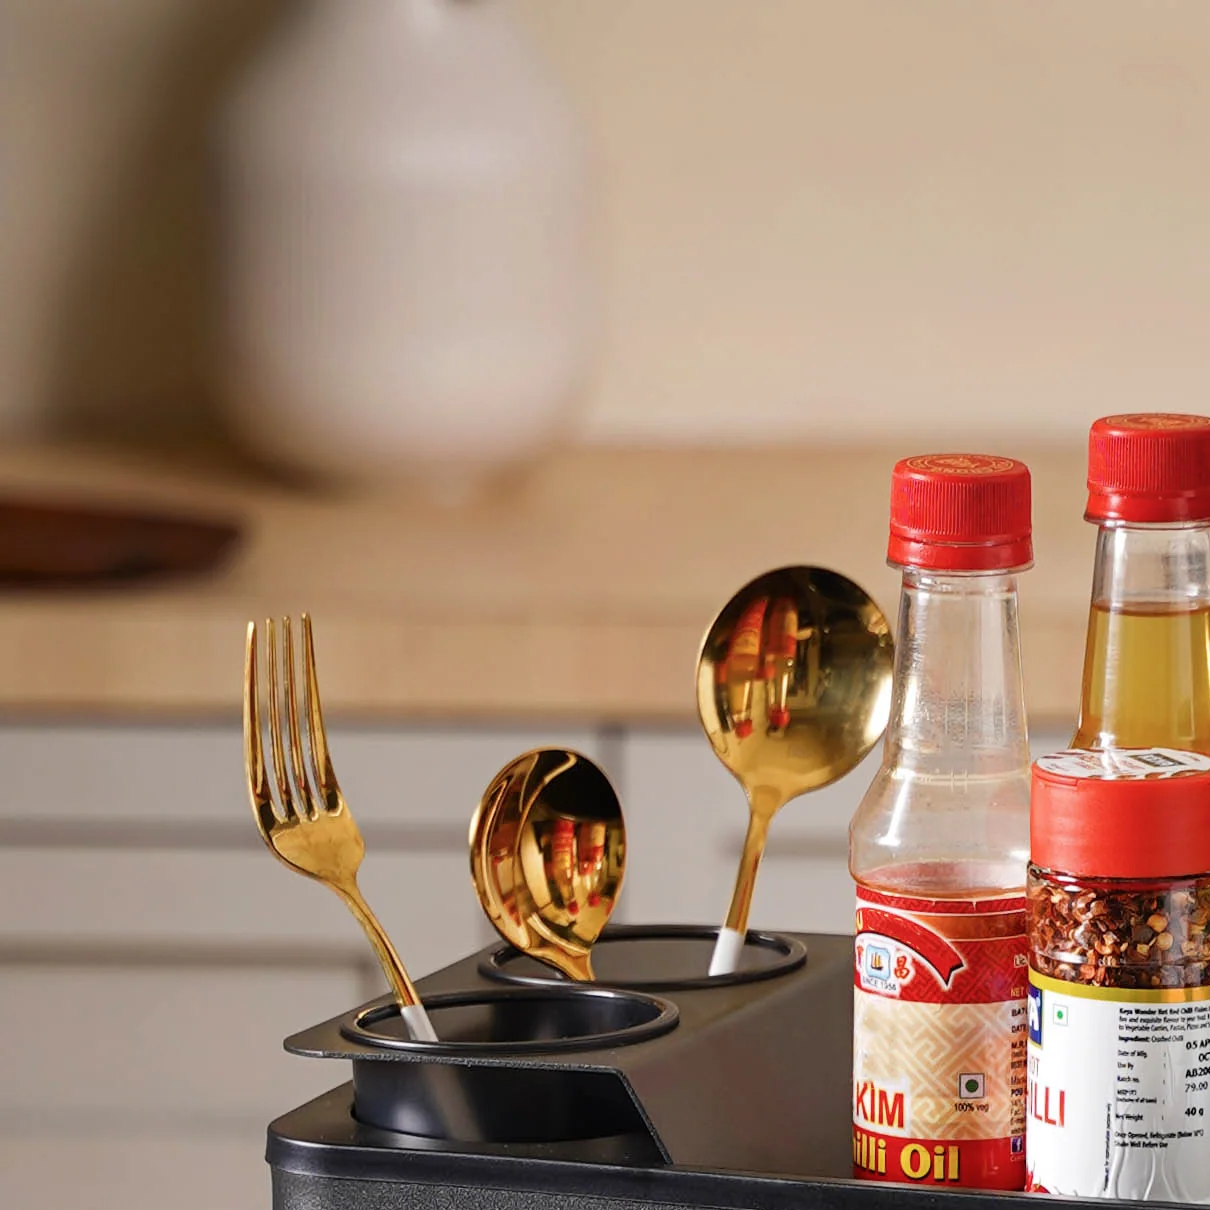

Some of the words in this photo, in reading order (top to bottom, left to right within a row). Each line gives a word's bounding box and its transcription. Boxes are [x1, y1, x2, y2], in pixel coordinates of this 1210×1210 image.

[1186, 1041, 1198, 1050] 05
[1185, 1081, 1209, 1093] 79.00
[856, 1081, 904, 1129] KIM
[954, 1103, 975, 1112] 100%
[977, 1105, 990, 1113] veg
[1185, 1107, 1197, 1117] 40
[900, 1143, 960, 1180] Oil
